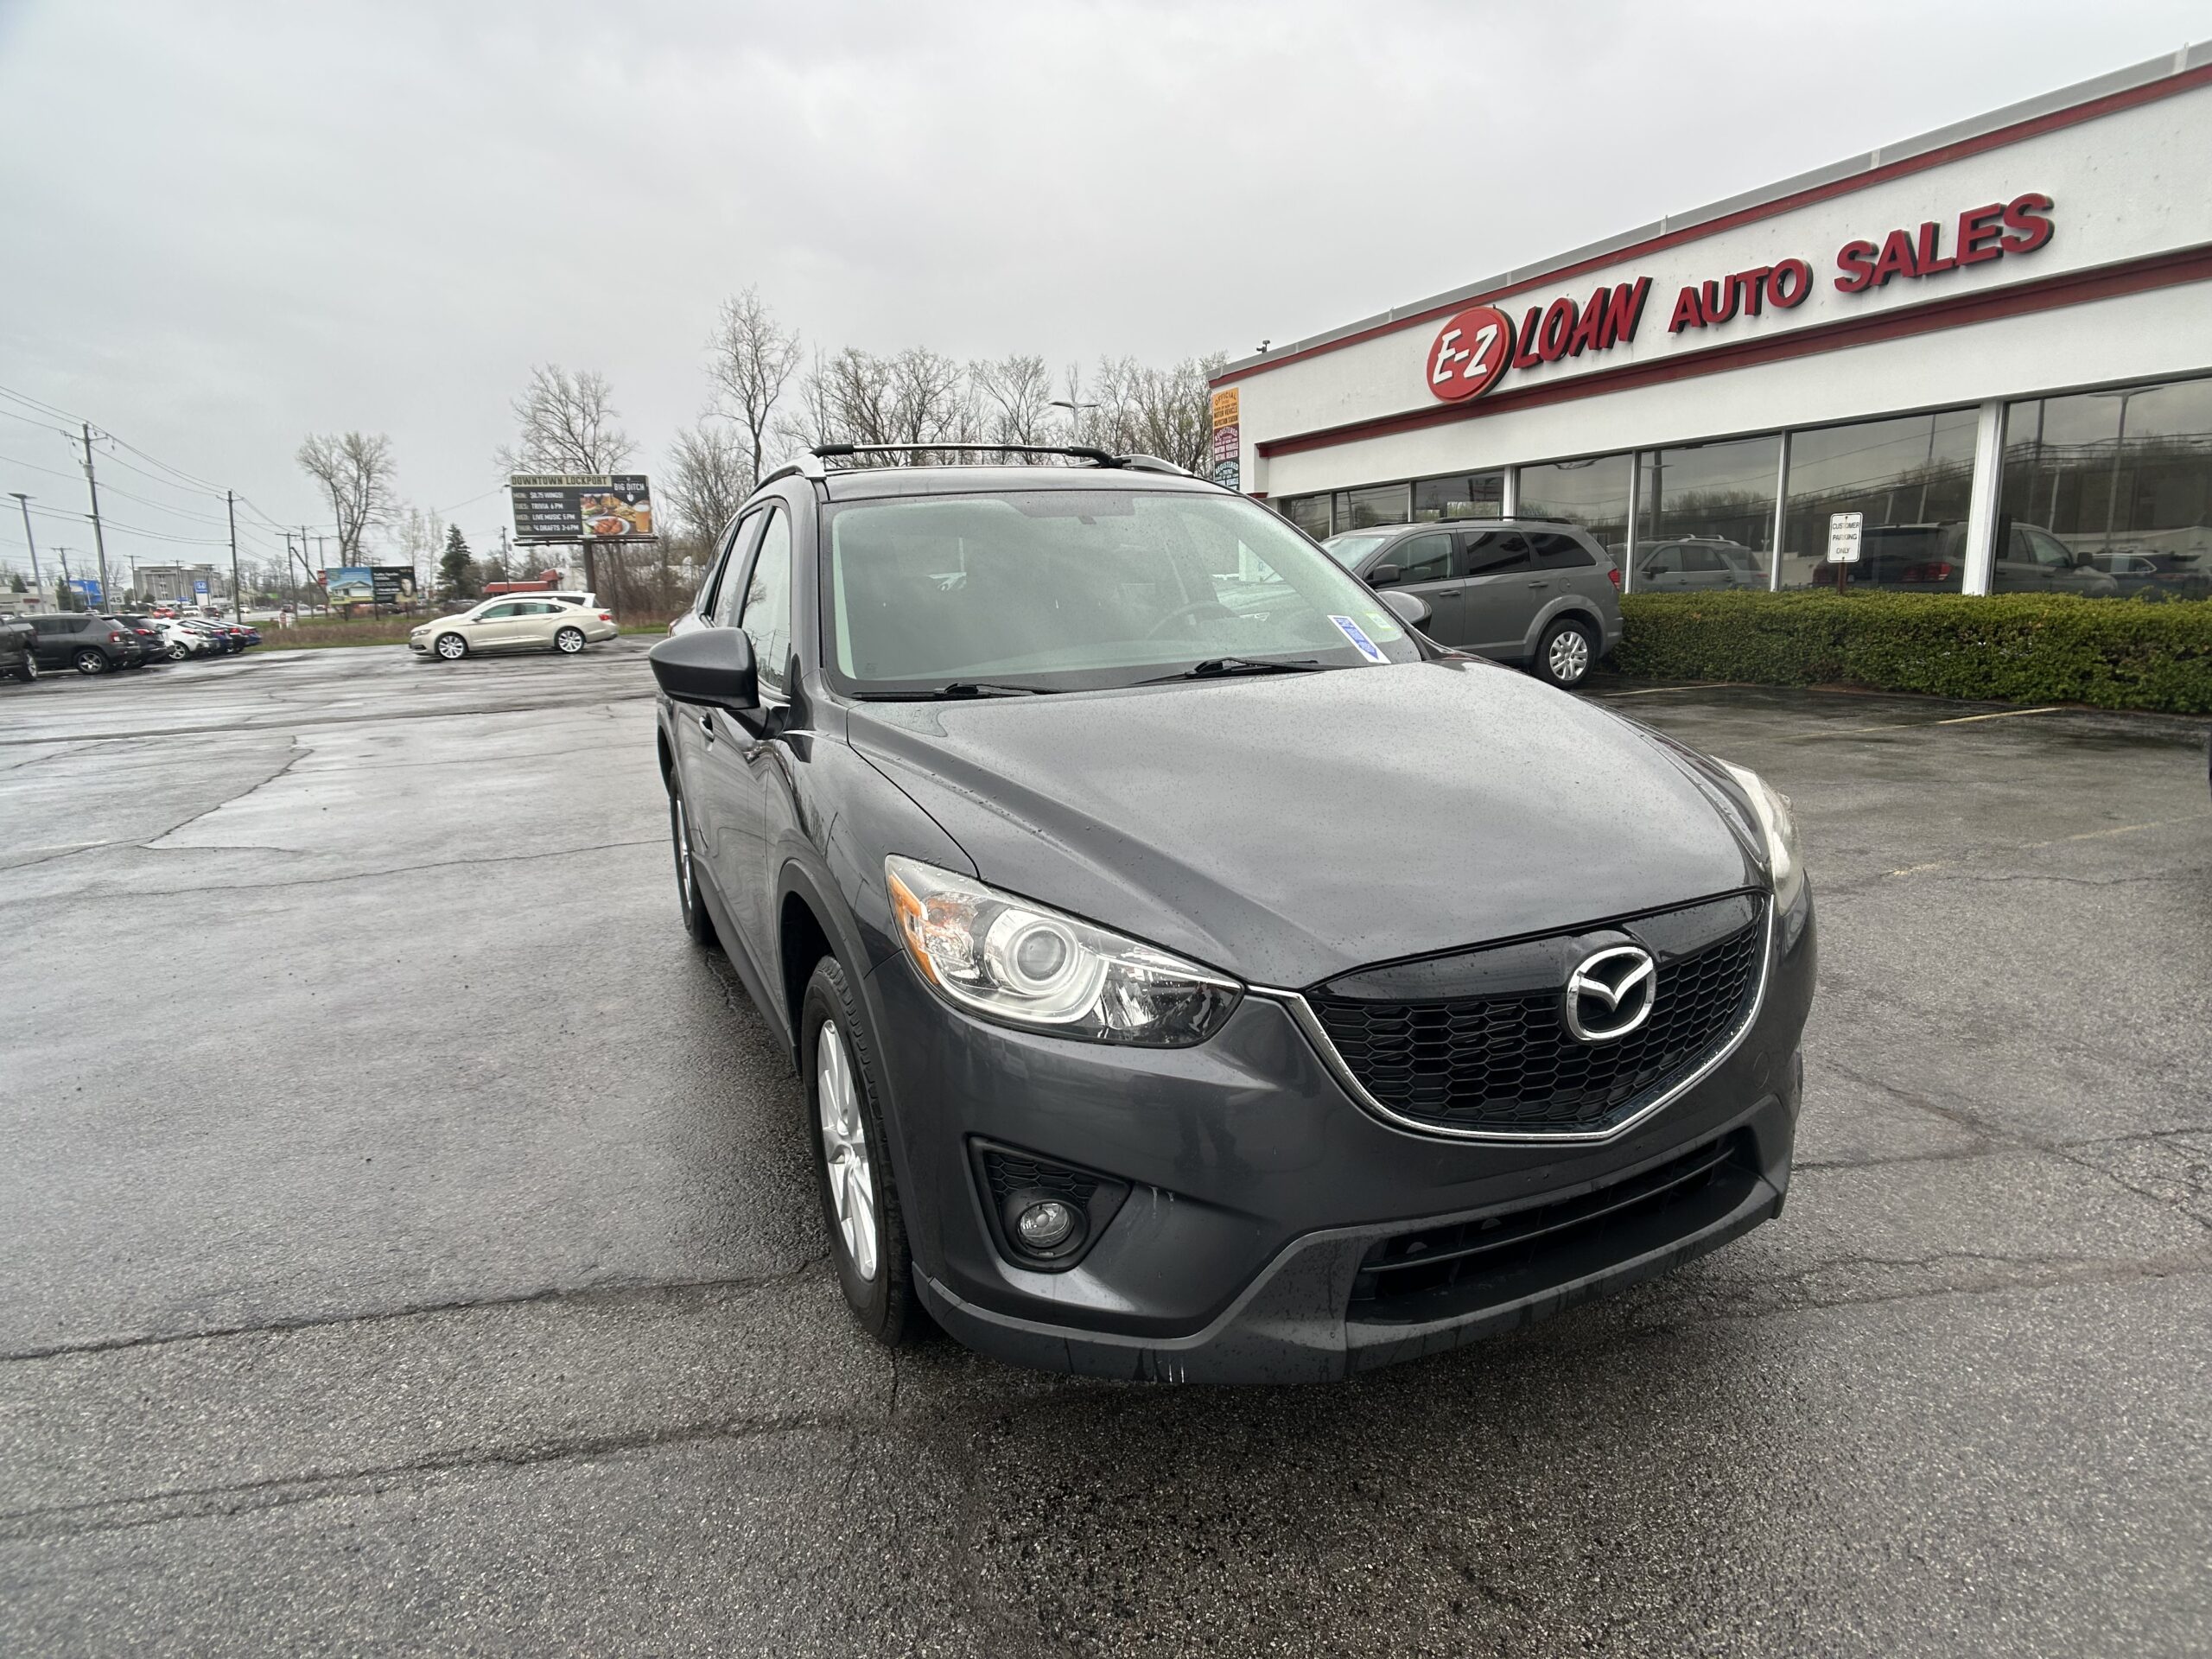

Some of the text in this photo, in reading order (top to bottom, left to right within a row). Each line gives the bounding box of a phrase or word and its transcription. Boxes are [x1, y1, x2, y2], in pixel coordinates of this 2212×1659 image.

[1433, 193, 2055, 385] E-Z LOAN AUTO SALES
[1214, 391, 1237, 406] OFFICIAL
[512, 476, 607, 485] DOWNTOWN LOCKPORT
[613, 482, 645, 491] BIG DITCH
